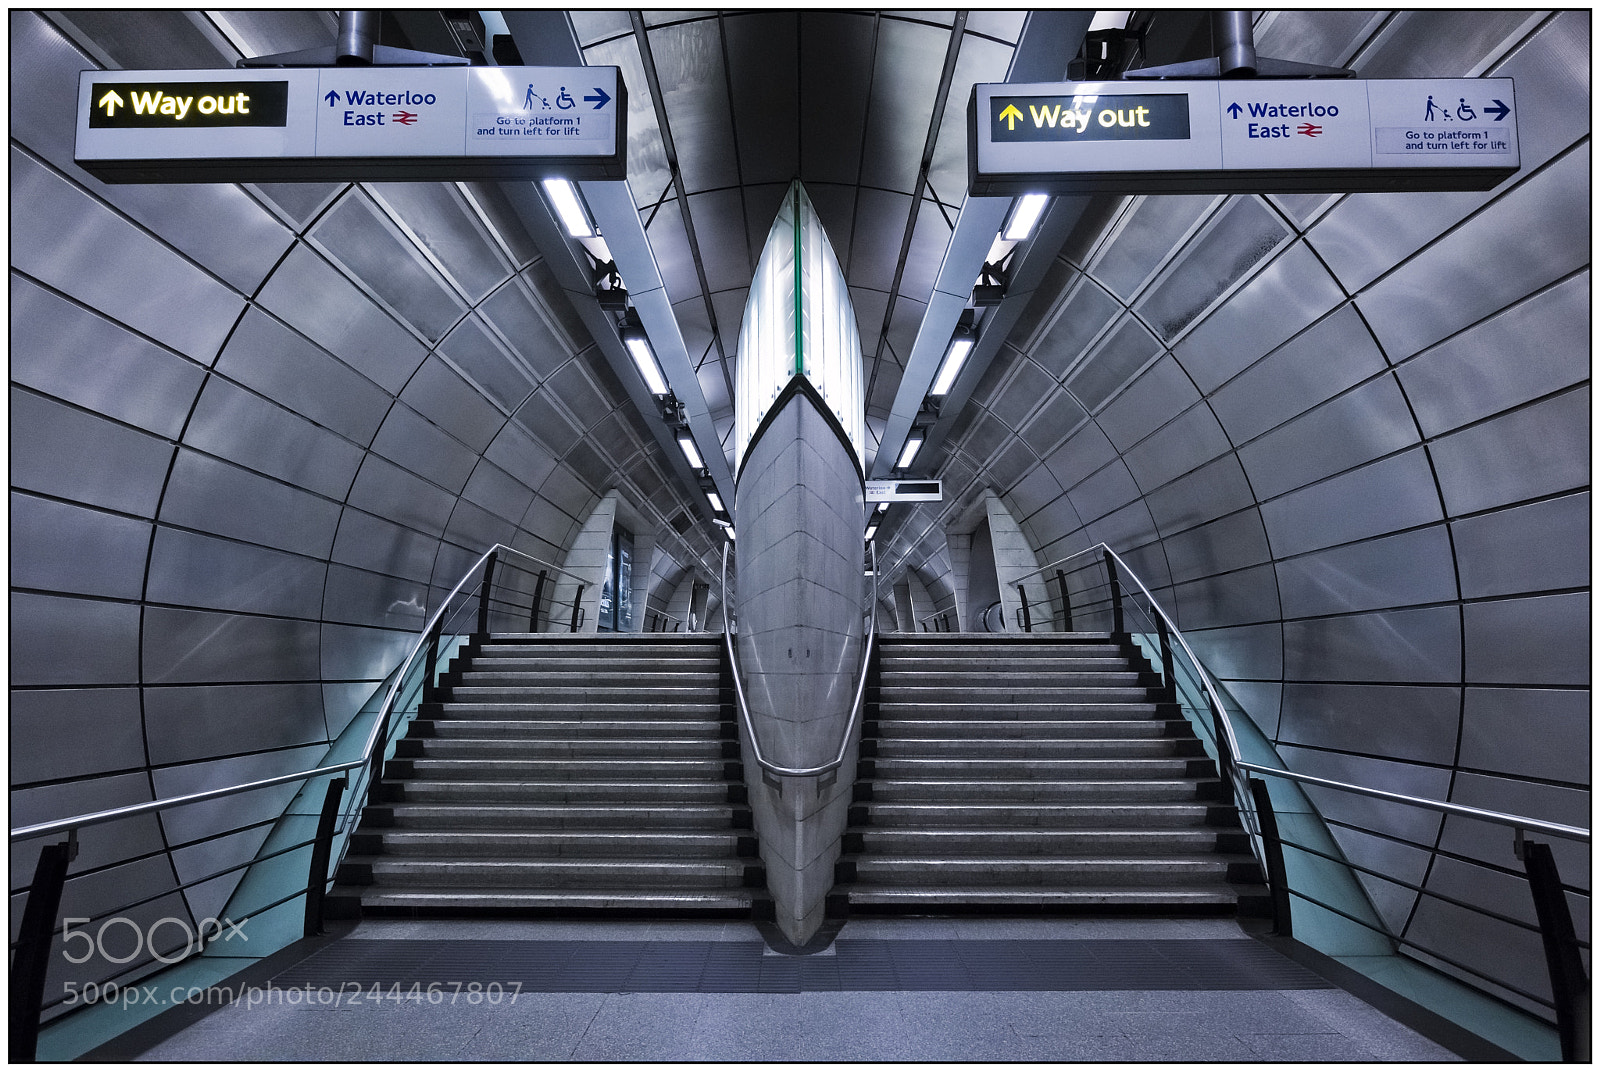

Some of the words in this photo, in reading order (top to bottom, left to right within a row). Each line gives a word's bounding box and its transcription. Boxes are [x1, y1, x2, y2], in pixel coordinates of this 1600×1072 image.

[345, 90, 436, 105] Waterloo
[130, 91, 193, 120] Way
[197, 92, 250, 114] out
[1247, 102, 1339, 118] Waterloo
[343, 111, 385, 126] East
[496, 117, 511, 125] Go
[515, 117, 526, 125] to
[529, 117, 573, 127] platform
[576, 117, 581, 125] 1
[1029, 104, 1092, 133] Way
[1098, 105, 1151, 127] out
[477, 127, 495, 135] and
[499, 127, 520, 135] turn
[523, 127, 542, 135] left
[546, 127, 560, 135] for
[564, 127, 580, 135] lift
[1248, 123, 1290, 138] East
[1405, 131, 1420, 139] Go
[1423, 131, 1435, 139] to
[1438, 131, 1481, 141] platform
[1484, 131, 1488, 139] 1
[1405, 141, 1423, 150] and
[1427, 141, 1448, 150] turn
[1451, 141, 1470, 150] left
[1473, 141, 1488, 150] for
[1491, 141, 1507, 150] lift
